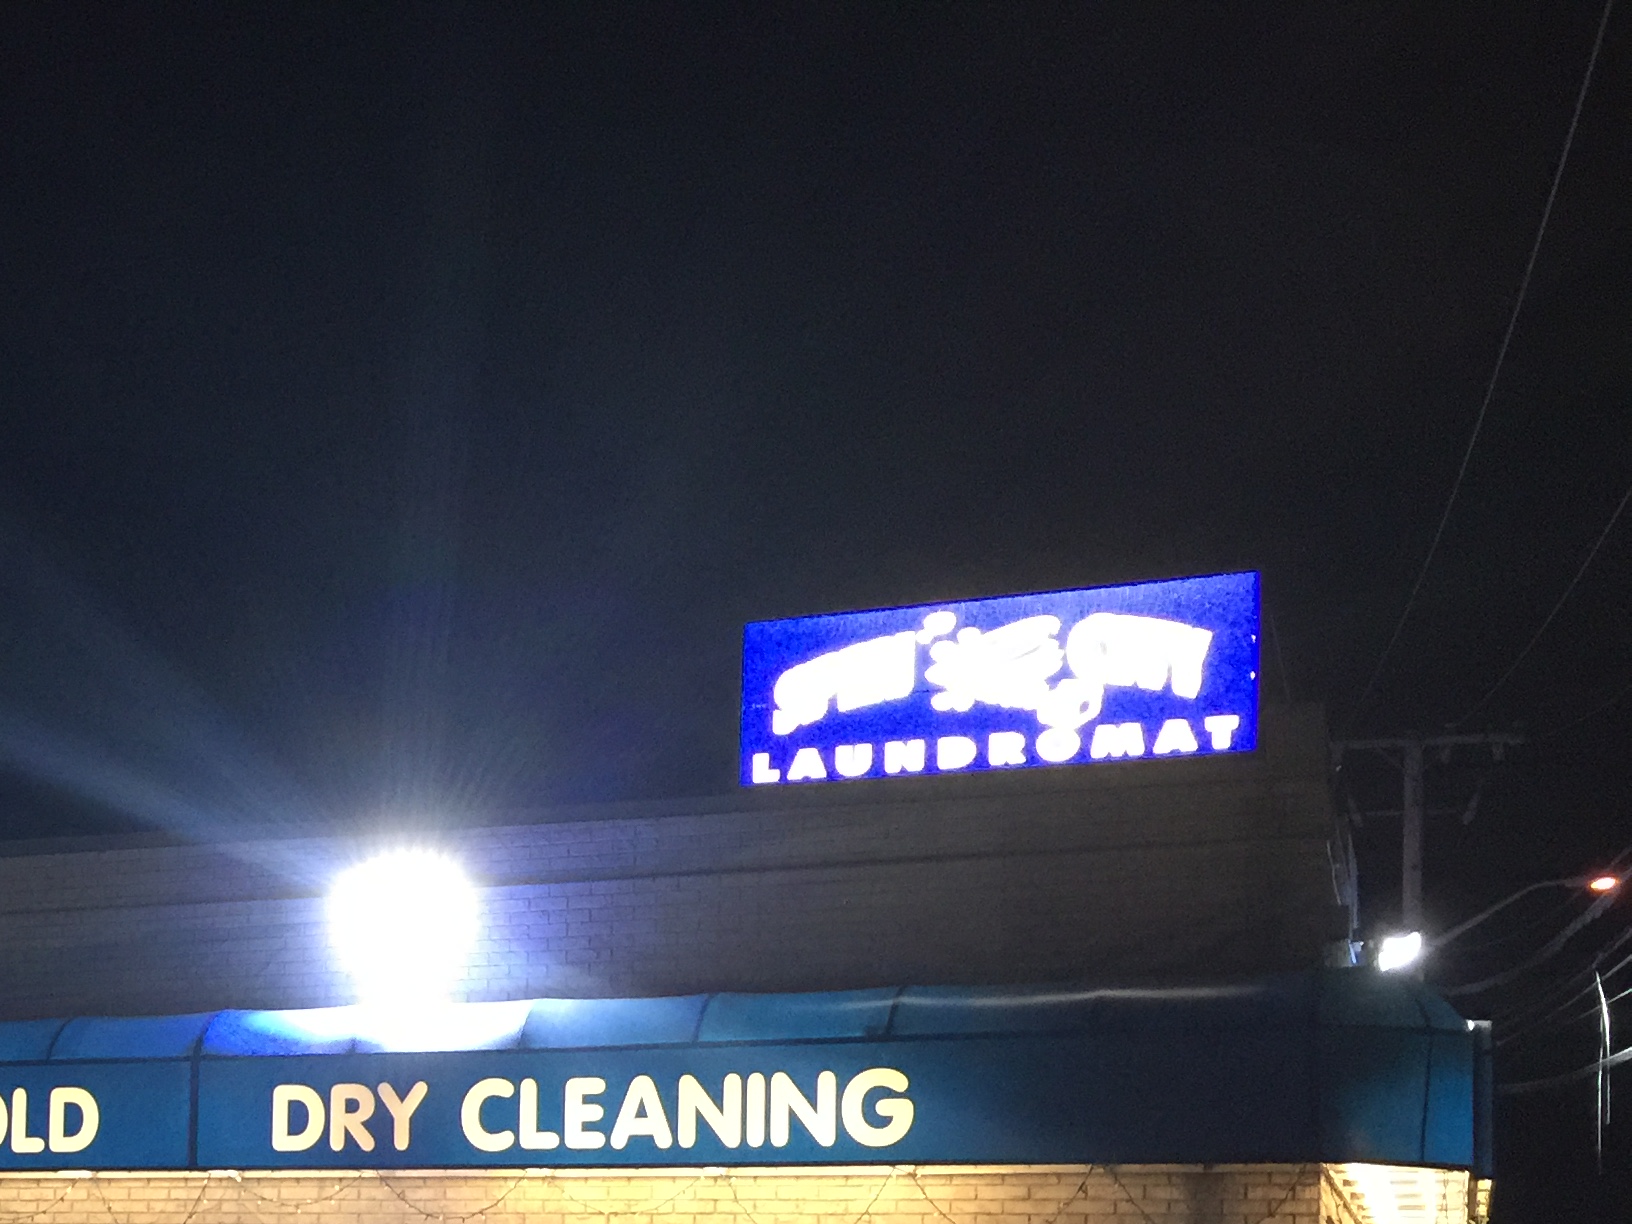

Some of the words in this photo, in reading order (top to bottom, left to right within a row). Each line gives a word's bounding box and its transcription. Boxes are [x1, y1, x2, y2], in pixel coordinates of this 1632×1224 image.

[752, 715, 1240, 784] LAUNDROMAT
[272, 1081, 428, 1152] DRY
[461, 1068, 915, 1152] CLEANING
